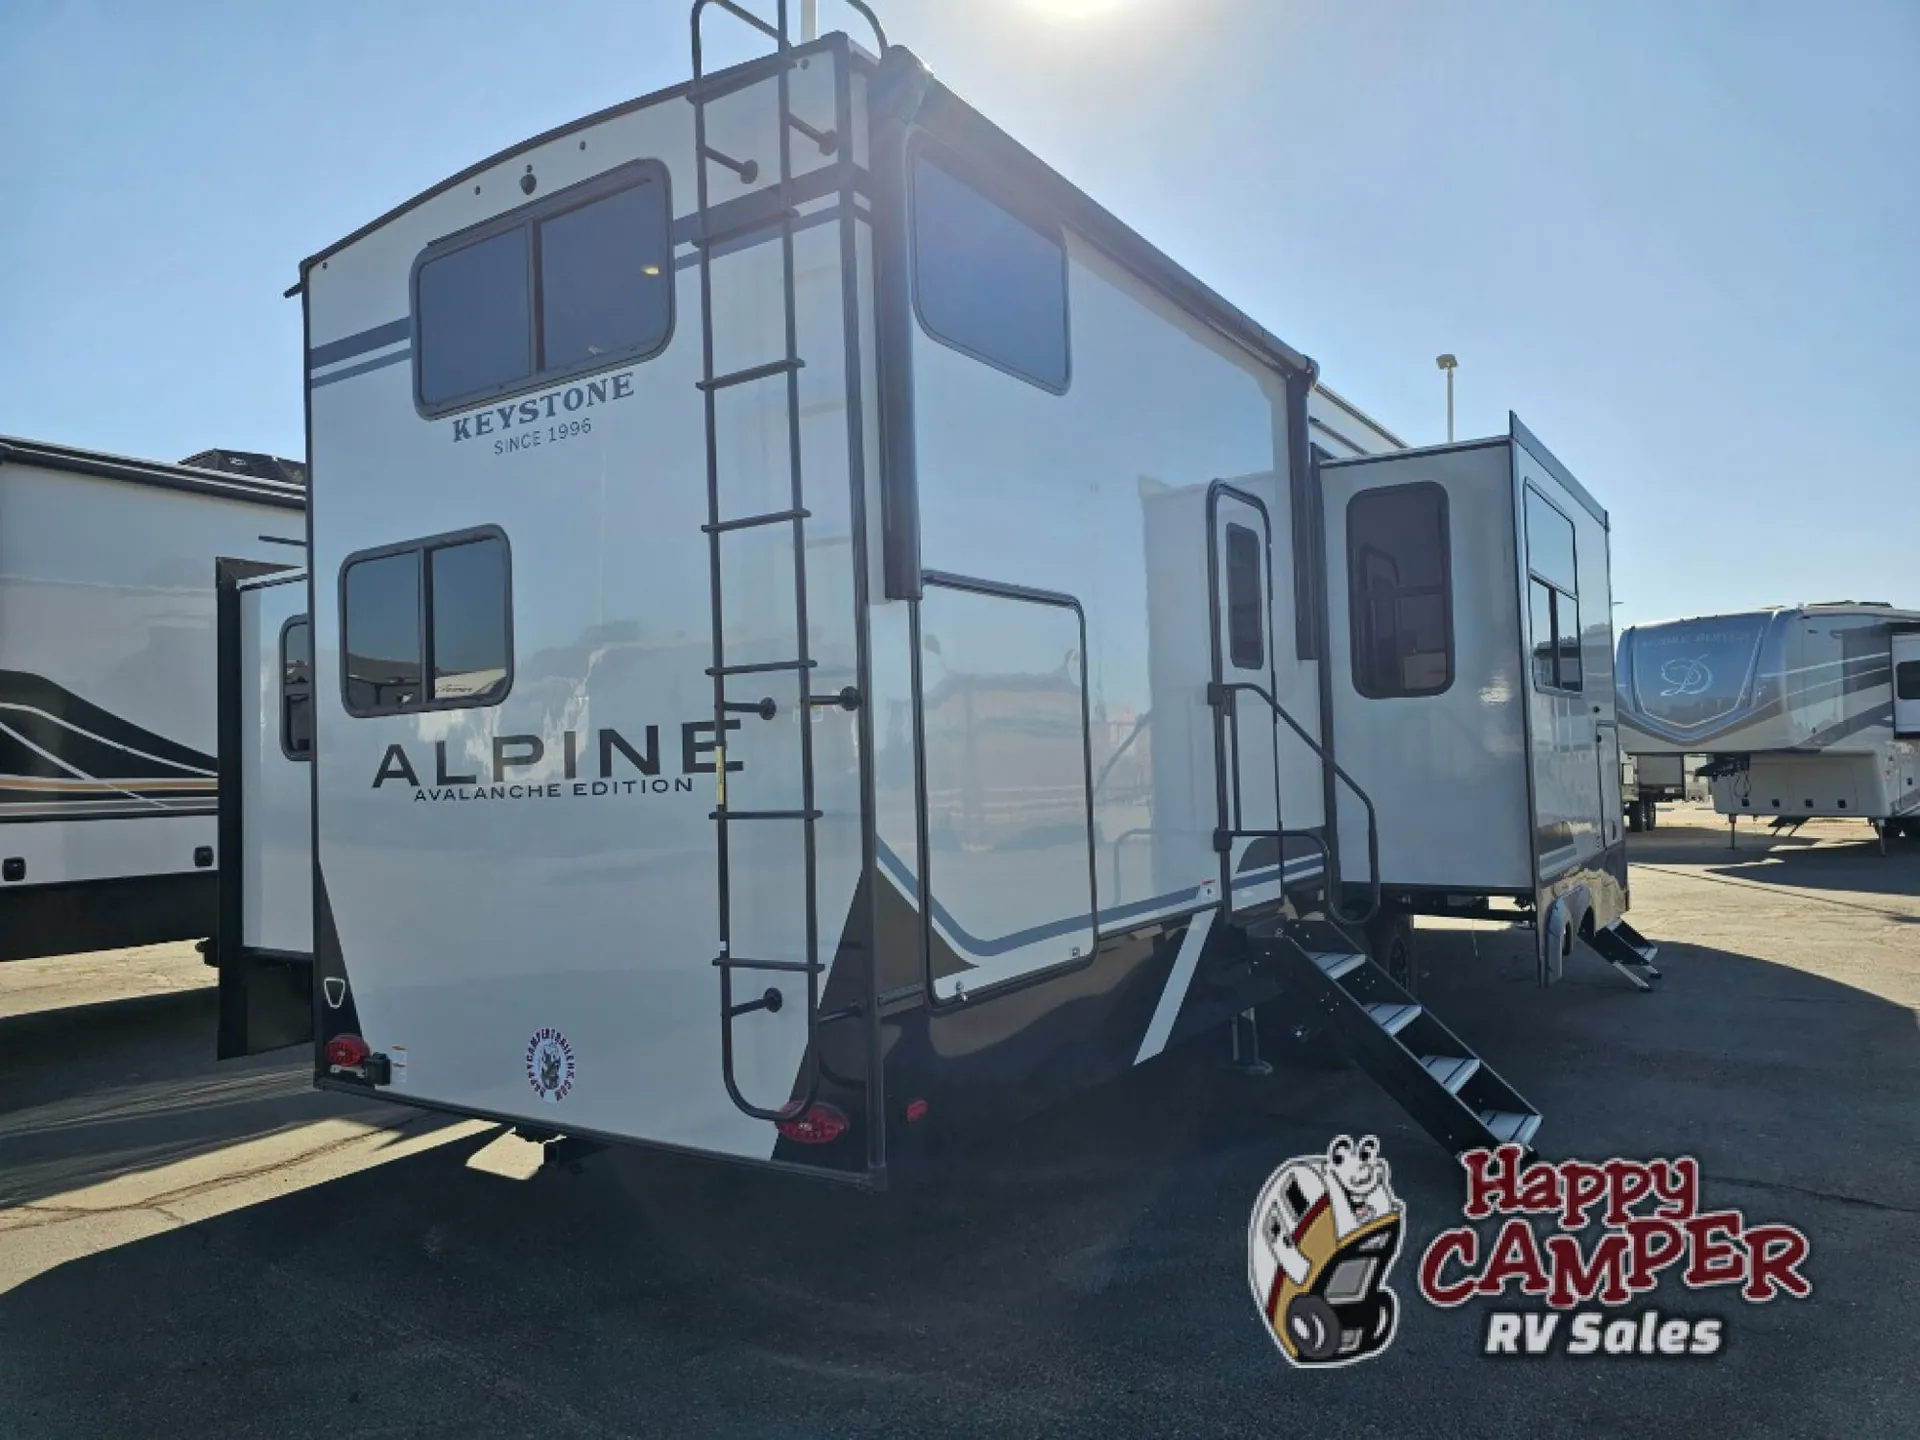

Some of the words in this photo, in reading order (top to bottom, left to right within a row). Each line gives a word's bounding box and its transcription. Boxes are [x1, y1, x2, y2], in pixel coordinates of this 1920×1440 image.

[452, 372, 635, 443] KEYSTONE
[494, 430, 541, 455] SINCE
[548, 417, 592, 444] 1996
[372, 719, 744, 789] ALPINE
[414, 783, 561, 802] AVALANCHE
[573, 778, 693, 797] EDITION
